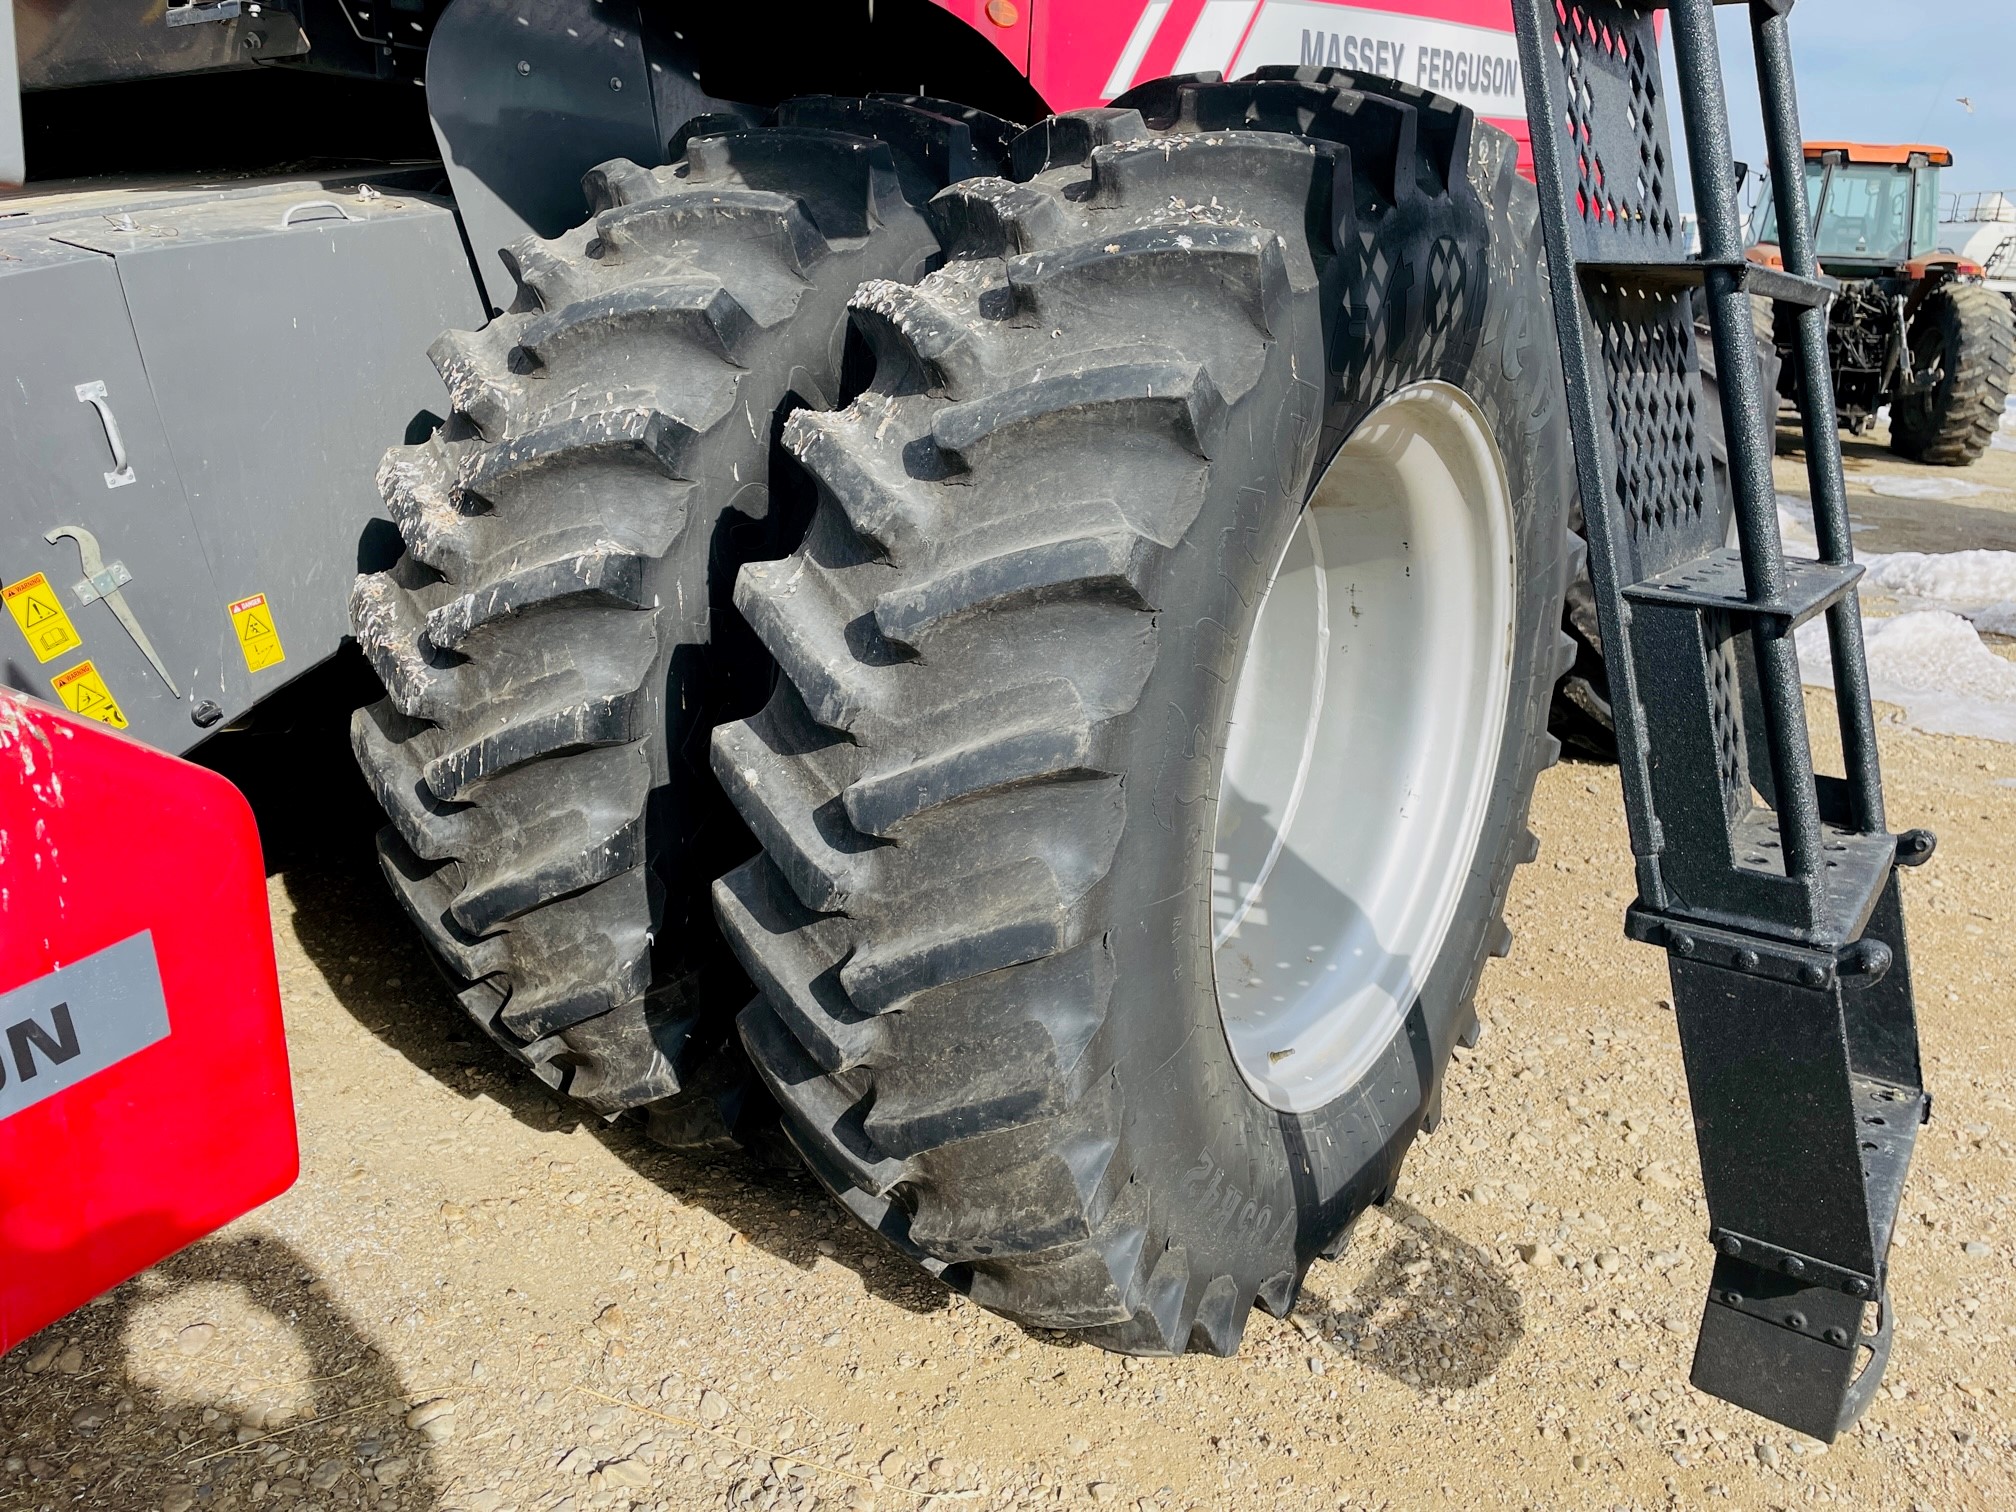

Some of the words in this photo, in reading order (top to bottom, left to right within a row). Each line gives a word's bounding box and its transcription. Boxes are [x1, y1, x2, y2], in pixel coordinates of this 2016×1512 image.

[1301, 29, 1404, 80] MASSEY
[1416, 45, 1519, 97] FERGUSON
[16, 577, 42, 592] WARNING
[240, 597, 262, 610] DANGER
[66, 665, 91, 682] WARNING
